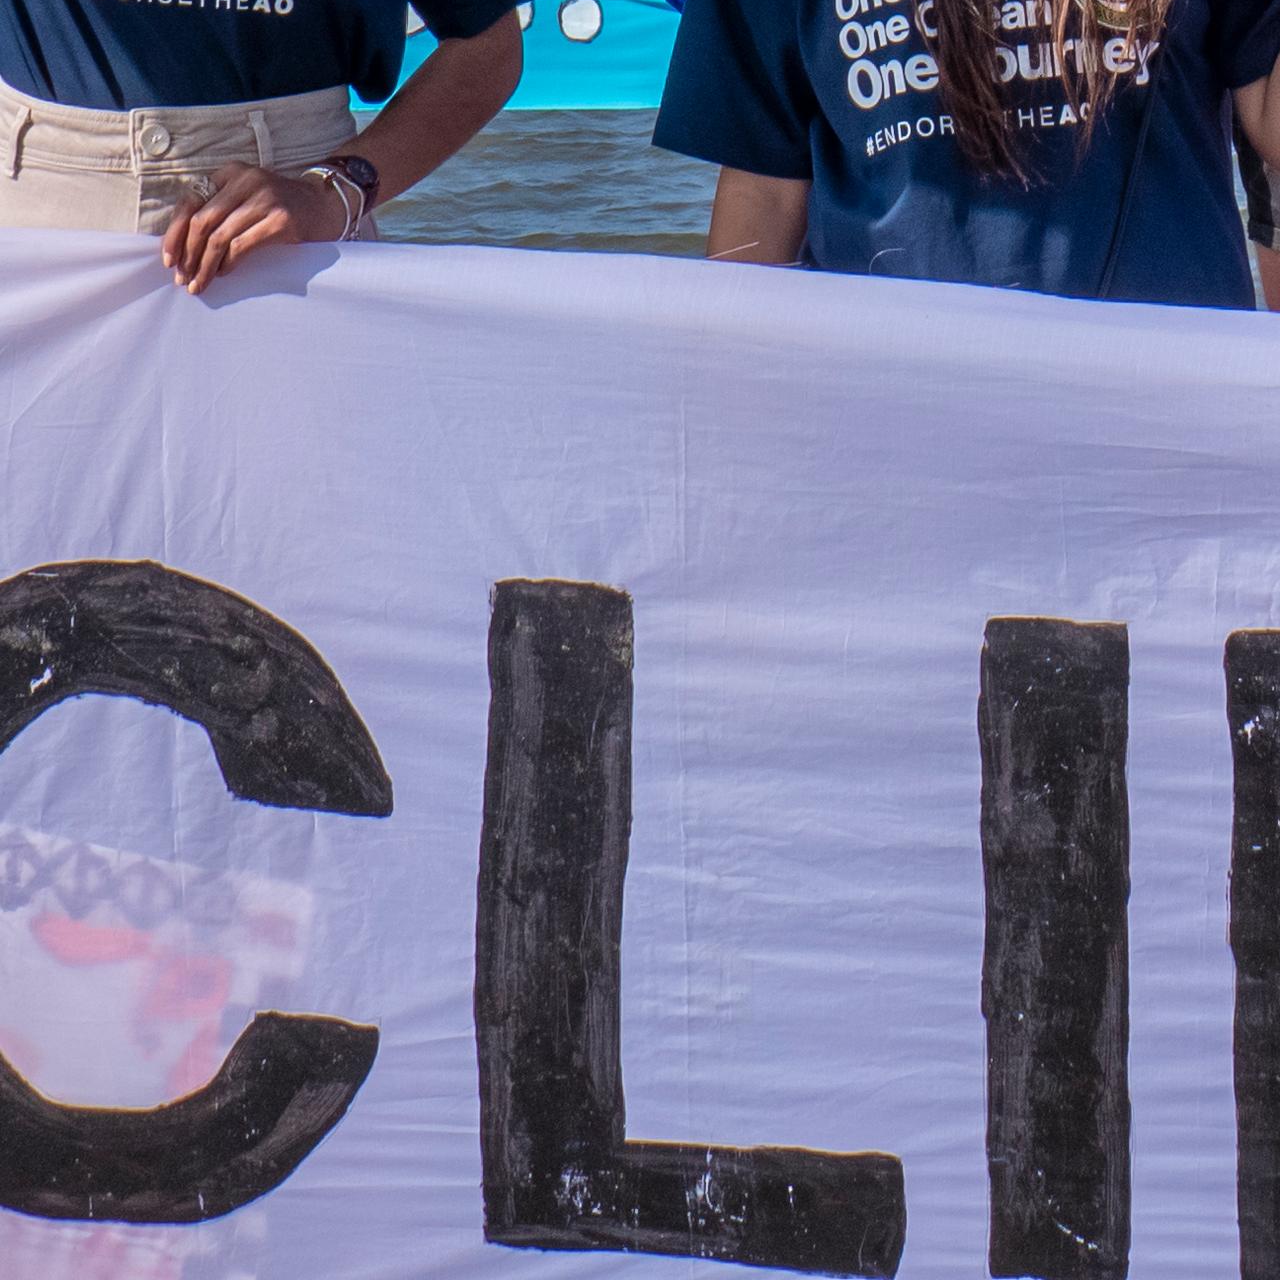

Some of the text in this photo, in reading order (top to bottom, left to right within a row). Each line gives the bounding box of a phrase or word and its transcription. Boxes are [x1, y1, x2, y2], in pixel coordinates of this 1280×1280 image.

[839, 14, 910, 60] One
[847, 37, 1161, 110] One ourney
